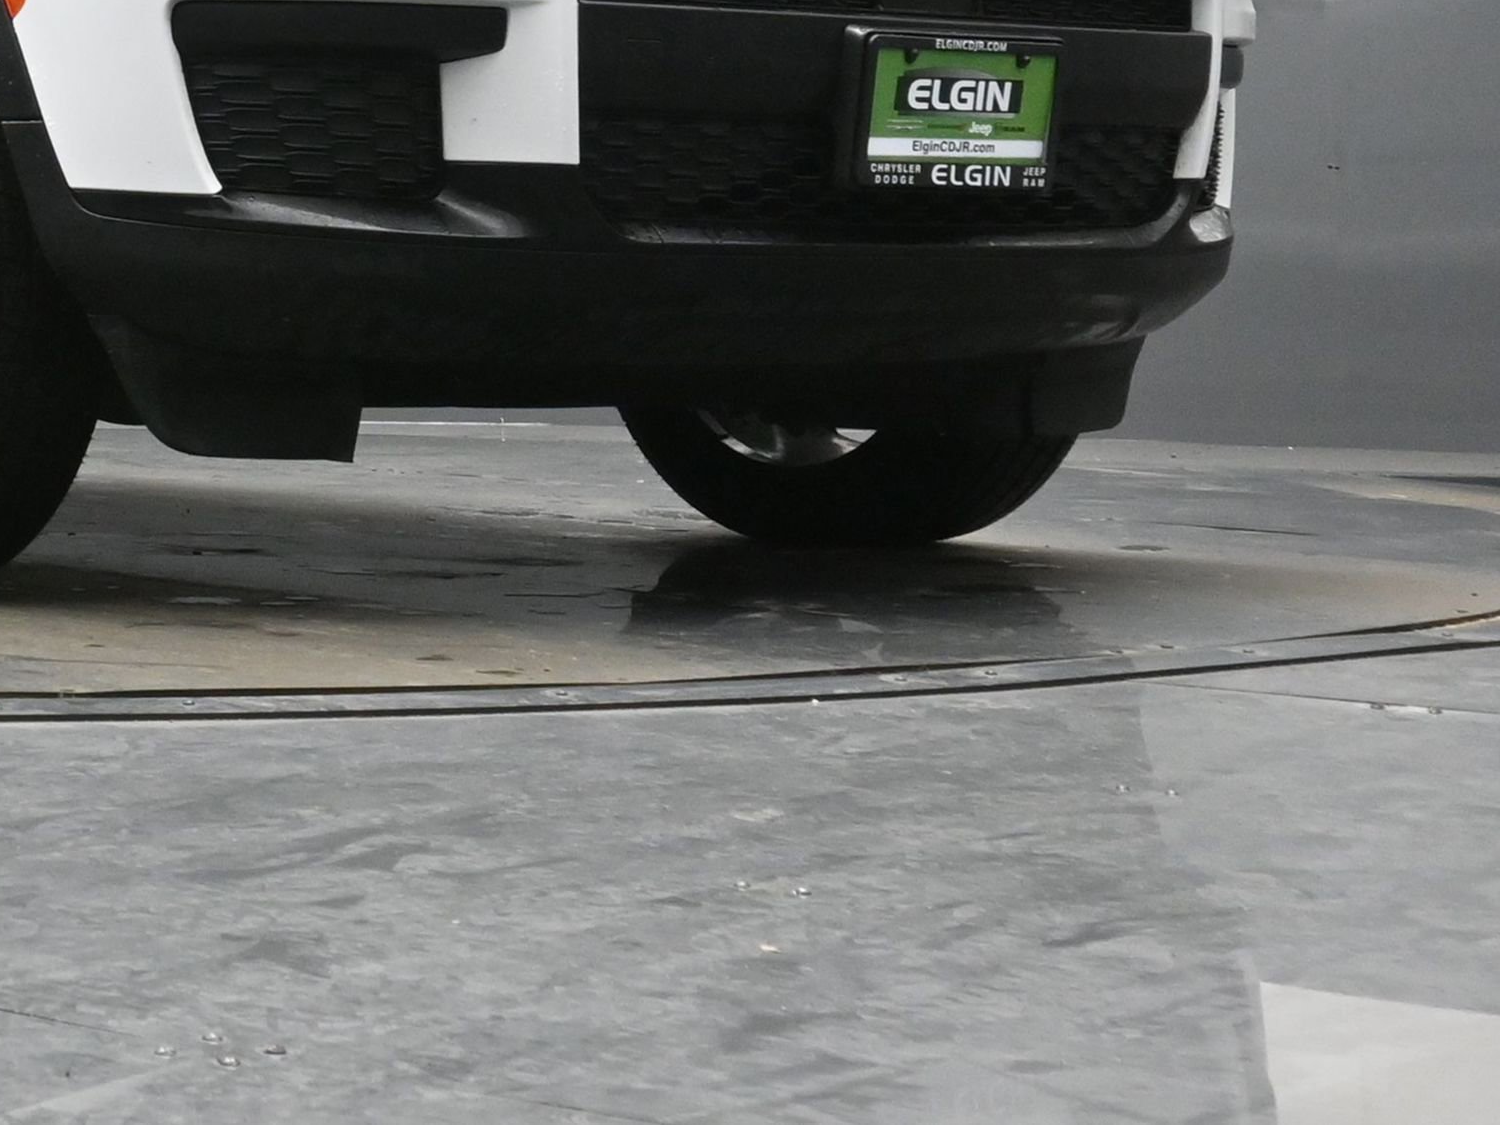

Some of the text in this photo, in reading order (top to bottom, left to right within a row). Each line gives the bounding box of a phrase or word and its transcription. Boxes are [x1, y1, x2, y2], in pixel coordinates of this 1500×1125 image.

[935, 38, 1008, 52] ELGINCDJR.COM
[907, 78, 1013, 112] ELGIN
[968, 121, 994, 136] Jeep
[912, 140, 996, 155] ElginCDJR.com
[870, 162, 922, 174] CHRYSLER
[931, 163, 1012, 187] ELGIN
[1022, 167, 1047, 177] JEEP
[874, 174, 916, 185] DODGE
[1022, 178, 1046, 188] RAM
